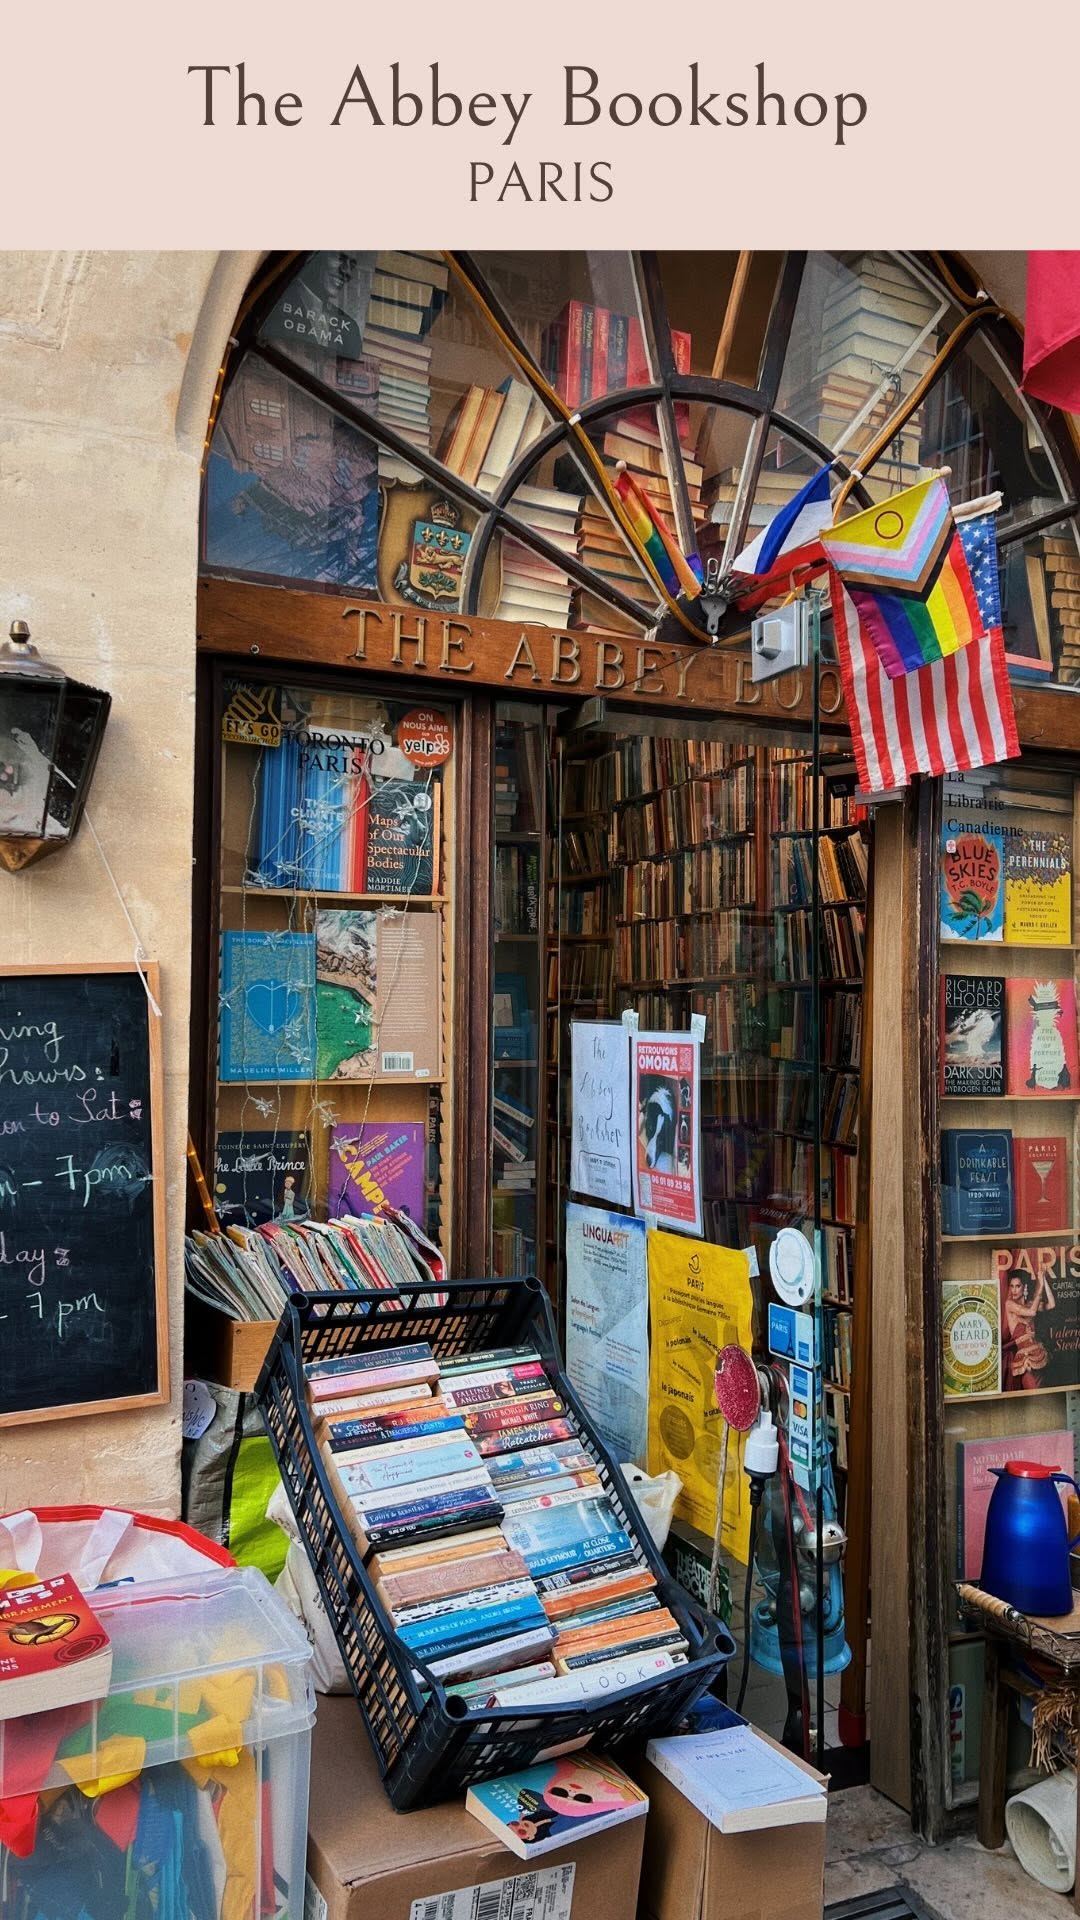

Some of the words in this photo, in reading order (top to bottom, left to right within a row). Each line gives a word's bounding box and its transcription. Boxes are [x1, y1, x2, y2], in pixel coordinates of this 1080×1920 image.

[283, 303, 350, 331] BARACK
[284, 319, 343, 344] OBAMA
[342, 606, 475, 673] THE
[504, 632, 696, 698] ABBEY
[418, 713, 434, 723] ON
[222, 720, 255, 736] ET'S
[261, 724, 279, 738] GO
[403, 722, 426, 731] NOUS
[428, 723, 449, 732] AIME
[282, 729, 385, 756] TORONTO
[404, 739, 435, 757] yelp
[298, 752, 363, 775] PARIS
[948, 772, 965, 783] La
[948, 793, 1005, 811] Librairie
[368, 814, 399, 827] Maps
[947, 818, 1024, 837] Canadienne
[381, 830, 406, 842] Our
[367, 842, 430, 857] Spectacular
[1030, 840, 1047, 852] THE
[950, 845, 995, 863] BLUE
[367, 856, 404, 869] Bodies
[1009, 856, 1067, 870] PERENNIALS
[949, 862, 997, 882] SKIES
[367, 876, 401, 885] MADDIE
[970, 879, 995, 894] BOYLE
[367, 885, 412, 894] MORTIMER
[946, 979, 1003, 993] RICHARD
[945, 992, 1001, 1007] RHODES
[230, 1067, 277, 1075] MADELINE
[638, 1056, 678, 1072] OMORA
[943, 1065, 974, 1080] DARK
[977, 1065, 1003, 1080] SUN
[944, 1085, 981, 1093] HYDROGEN
[983, 1085, 1002, 1093] BOMB
[29, 1102, 60, 1127] to
[429, 1116, 437, 1144] PARIS
[978, 1143, 986, 1153] A
[1028, 1145, 1057, 1153] PARIS
[267, 1156, 306, 1172] Prince
[960, 1157, 1007, 1169] DRINKABLE
[970, 1171, 997, 1184] FEAST
[996, 1246, 1080, 1281] PARIS
[687, 1277, 704, 1292] PARIS
[1052, 1281, 1074, 1290] CAPITAL
[58, 1292, 106, 1338] pm
[771, 1321, 789, 1335] PARIS
[959, 1319, 984, 1329] MARY
[953, 1330, 990, 1341] BEARD
[392, 1347, 419, 1357] TRAITOR
[456, 1386, 490, 1398] FALLING
[460, 1393, 491, 1405] ANGELS
[668, 1384, 694, 1403] japonais
[483, 1411, 498, 1421] THE
[499, 1404, 529, 1418] BORGIA
[529, 1400, 550, 1411] RING
[501, 1416, 521, 1426] MICHAEL
[522, 1412, 539, 1422] WHITE
[498, 1426, 524, 1439] JAMES
[793, 1421, 809, 1438] VISA
[502, 1430, 553, 1448] Ratcatcher
[547, 1550, 578, 1564] SEYMOUR
[583, 1541, 590, 1549] AT
[590, 1536, 610, 1547] CLOSE
[584, 1543, 617, 1557] QUARTERS
[416, 1624, 450, 1638] RUMOURS
[579, 1667, 647, 1693] LOOK
